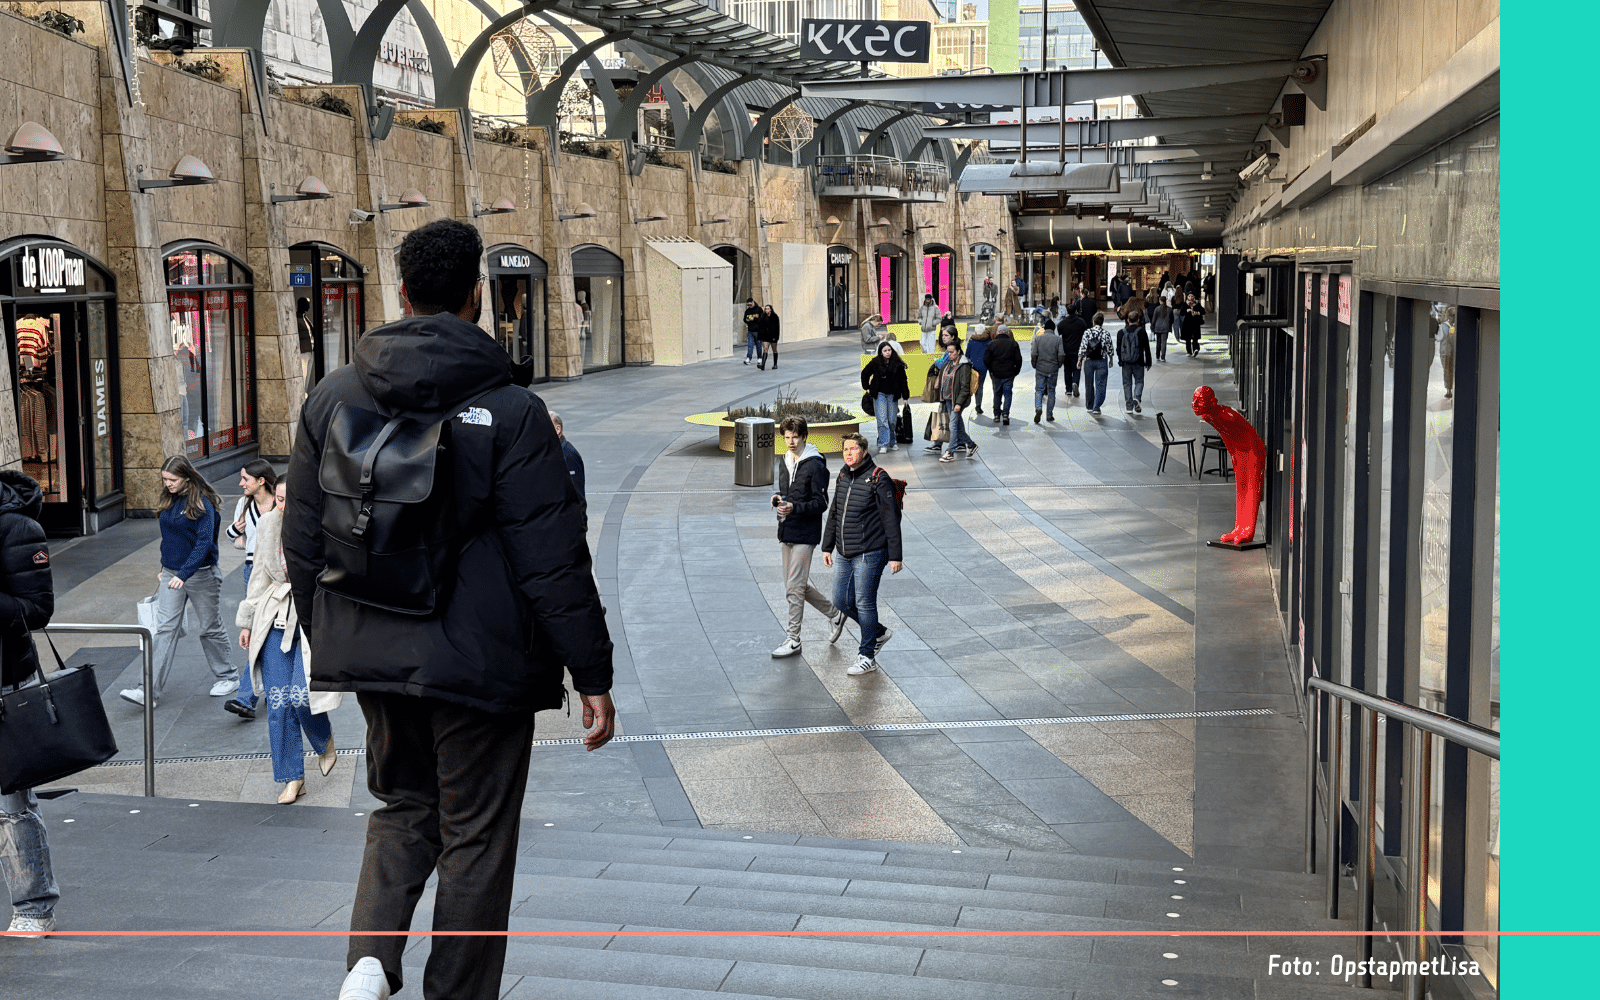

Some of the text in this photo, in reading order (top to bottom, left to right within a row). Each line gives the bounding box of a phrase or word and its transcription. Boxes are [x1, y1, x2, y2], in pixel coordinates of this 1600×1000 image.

[22, 245, 85, 288] de KOOPman
[94, 359, 107, 437] DAMES
[457, 411, 480, 420] NORTH
[462, 417, 481, 425] FACE
[735, 432, 749, 441] OOP
[735, 440, 749, 448] OOT
